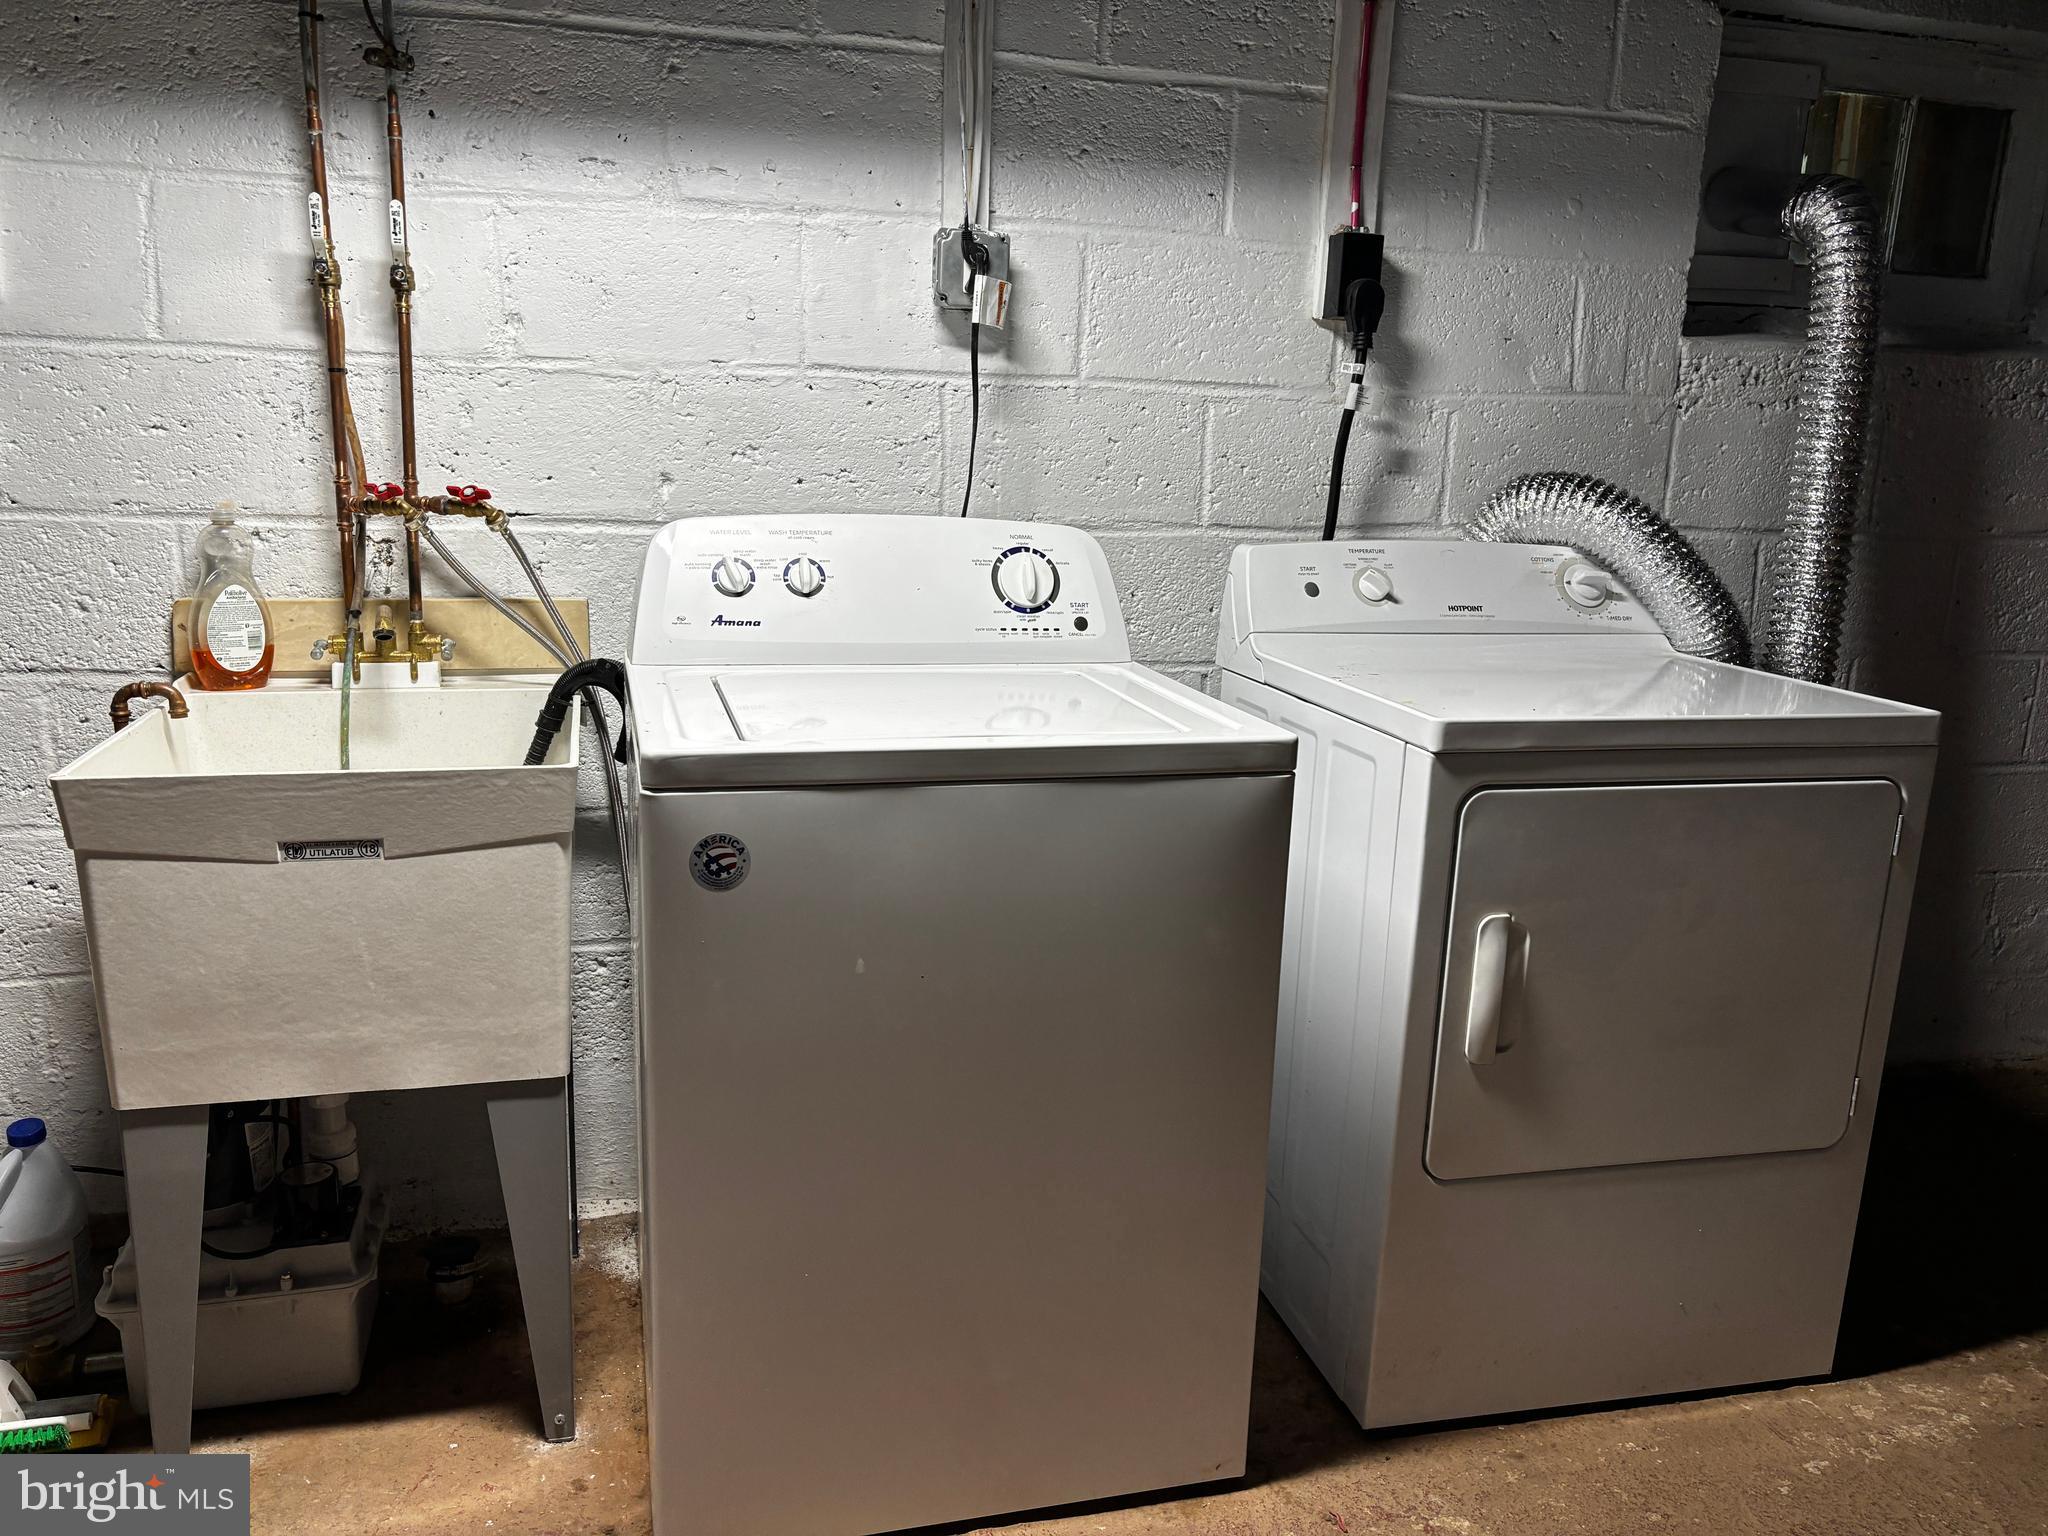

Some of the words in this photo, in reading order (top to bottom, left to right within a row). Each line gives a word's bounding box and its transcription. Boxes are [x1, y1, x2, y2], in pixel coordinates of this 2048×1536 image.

[711, 614, 762, 627] Amana
[309, 848, 354, 857] UTILATUB
[362, 843, 376, 854] 18
[694, 835, 745, 860] AMERICA
